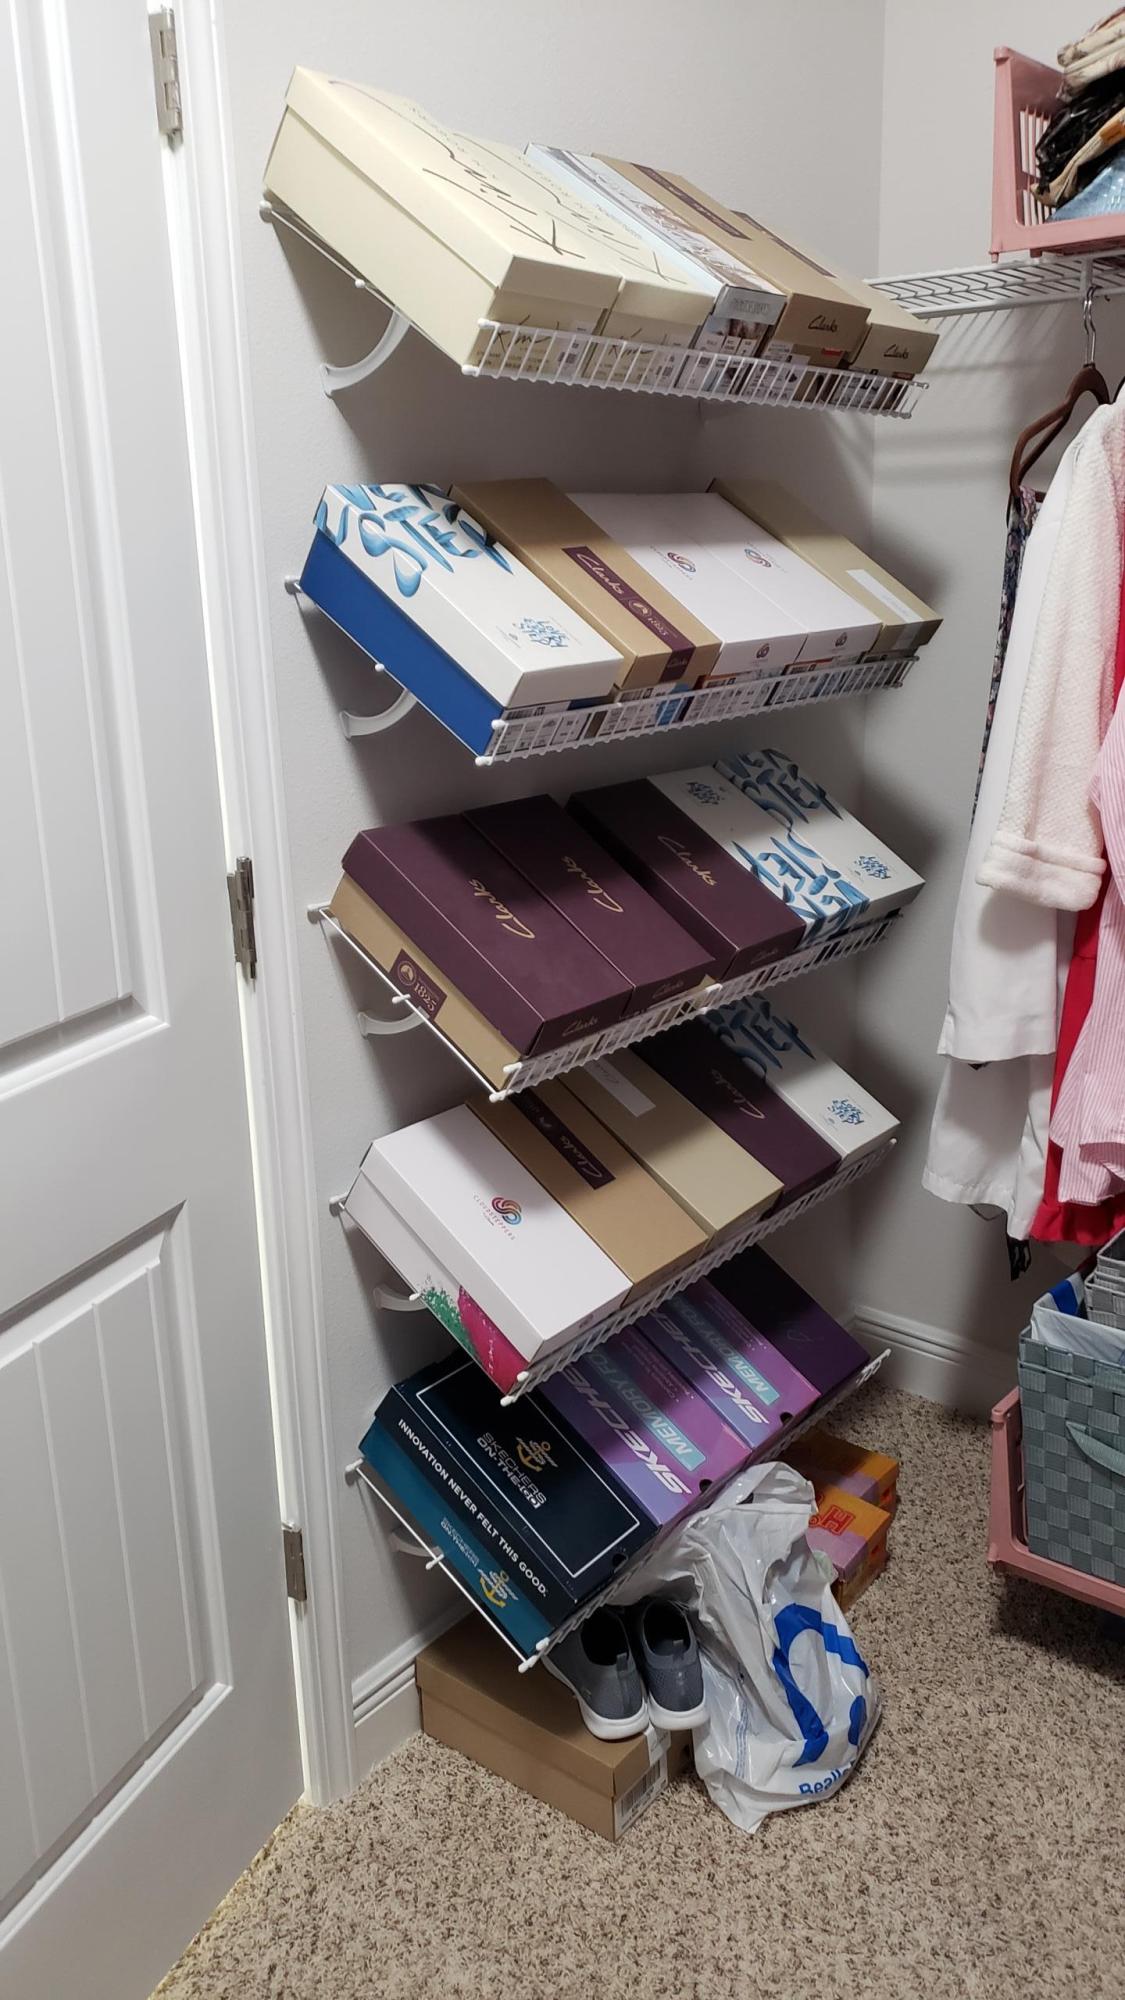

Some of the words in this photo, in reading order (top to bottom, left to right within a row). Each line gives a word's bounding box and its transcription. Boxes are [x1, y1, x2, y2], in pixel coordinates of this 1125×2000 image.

[576, 552, 624, 595] Clarks
[562, 855, 625, 913] Clarks
[657, 834, 718, 887] Clarks
[468, 878, 536, 939] Clarks
[414, 981, 438, 1012] 1825
[561, 1135, 602, 1177] Clarks
[590, 1353, 617, 1376] FO
[649, 1310, 770, 1424] SKECHE
[702, 1328, 769, 1392] MEMORY
[561, 1365, 693, 1494] SKECHE
[611, 1378, 693, 1456] MEMORY
[398, 1418, 449, 1481] INNOVATION
[448, 1478, 477, 1515] NEVER
[476, 1511, 499, 1539] FELT
[498, 1535, 519, 1563] THIS
[483, 1432, 547, 1505] SKECHERS
